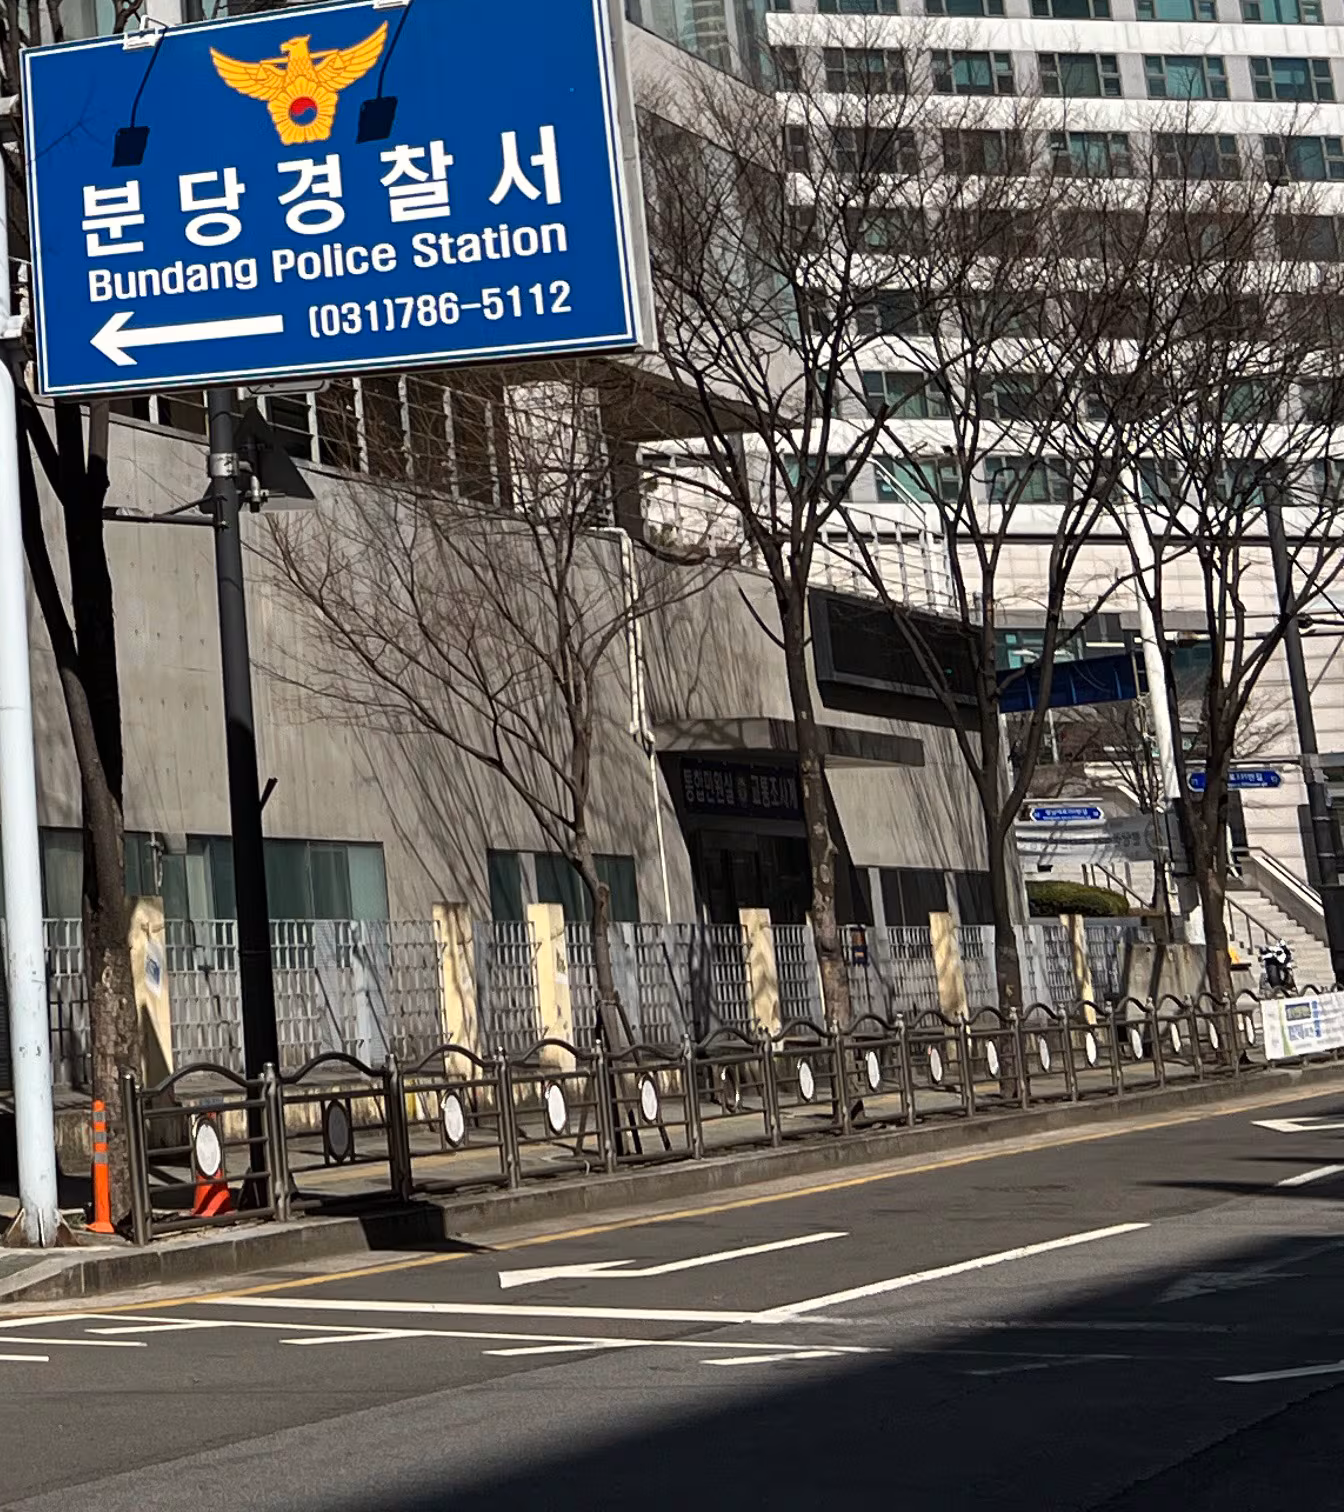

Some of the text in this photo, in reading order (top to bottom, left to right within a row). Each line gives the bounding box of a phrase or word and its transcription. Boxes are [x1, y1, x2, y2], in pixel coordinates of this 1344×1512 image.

[81, 124, 564, 259] 분당경찰서
[88, 221, 568, 303] Bundang Police Station
[308, 279, 573, 340] (031)786-5112
